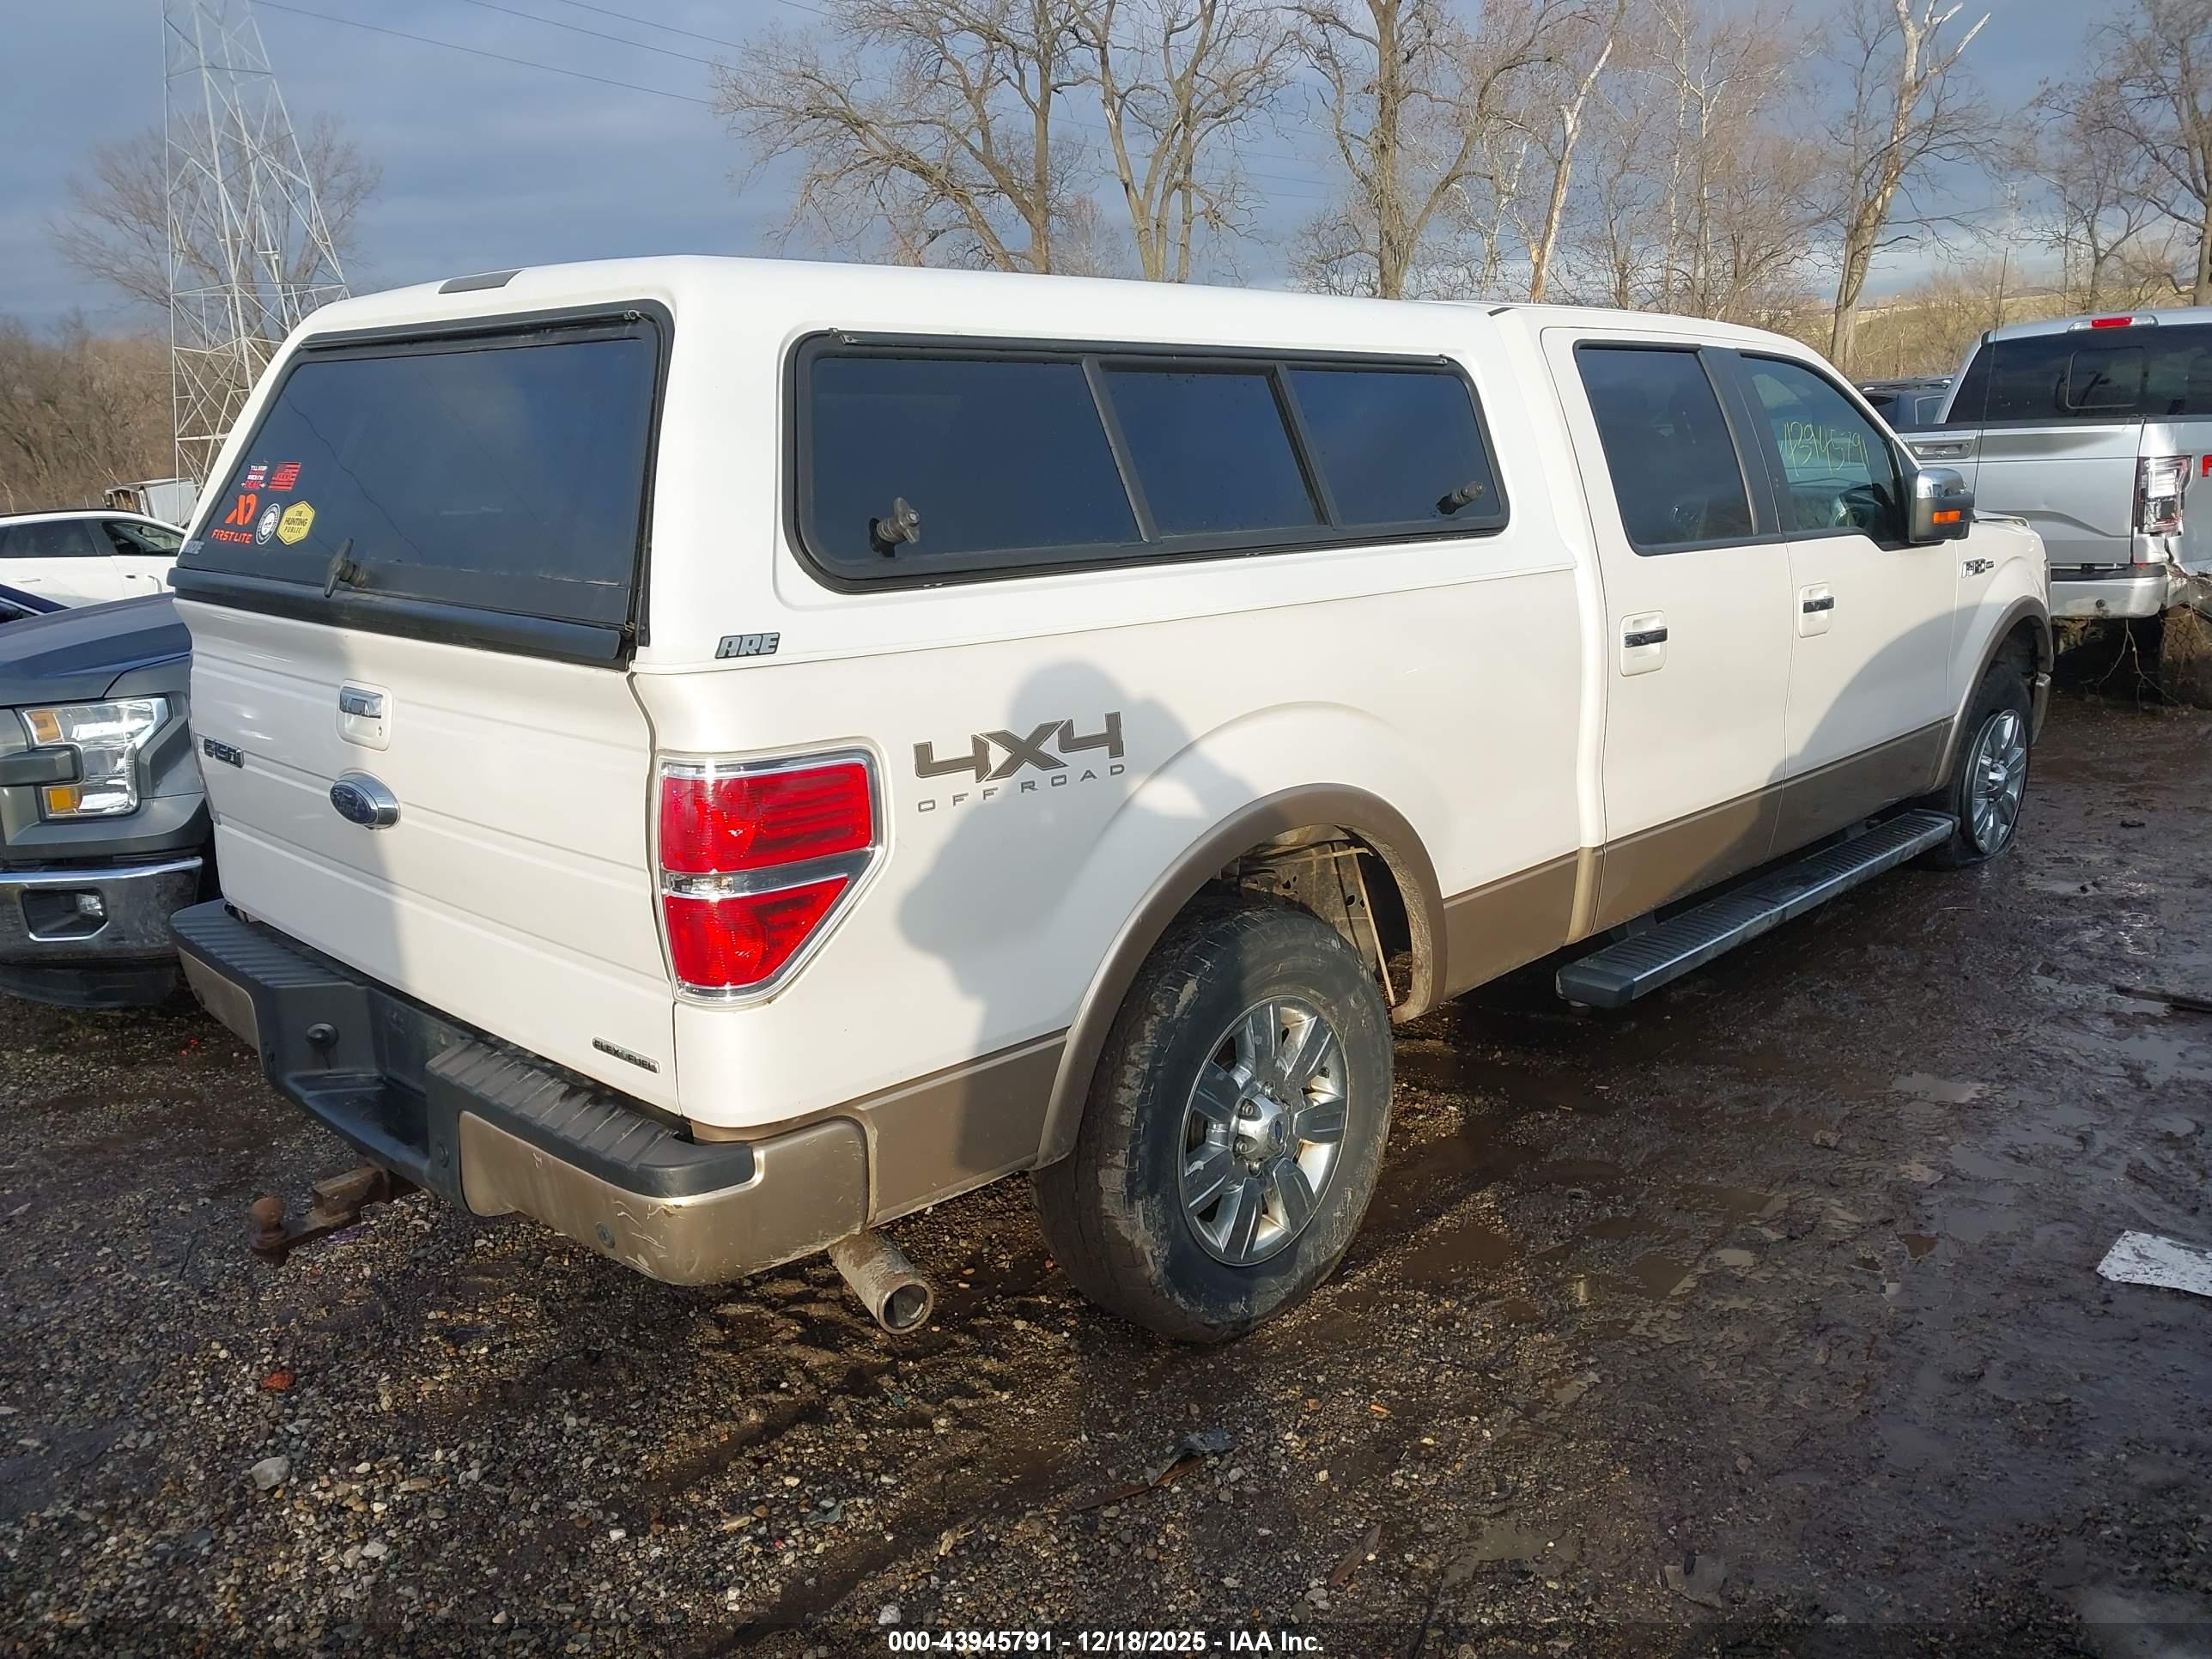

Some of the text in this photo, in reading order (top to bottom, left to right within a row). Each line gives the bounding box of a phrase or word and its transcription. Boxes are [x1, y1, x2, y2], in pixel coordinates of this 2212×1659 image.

[284, 517, 308, 526] HUNTING
[714, 632, 780, 659] ARE
[917, 763, 1125, 812] OFF ROAD
[593, 1039, 654, 1073] FLEX FUEL
